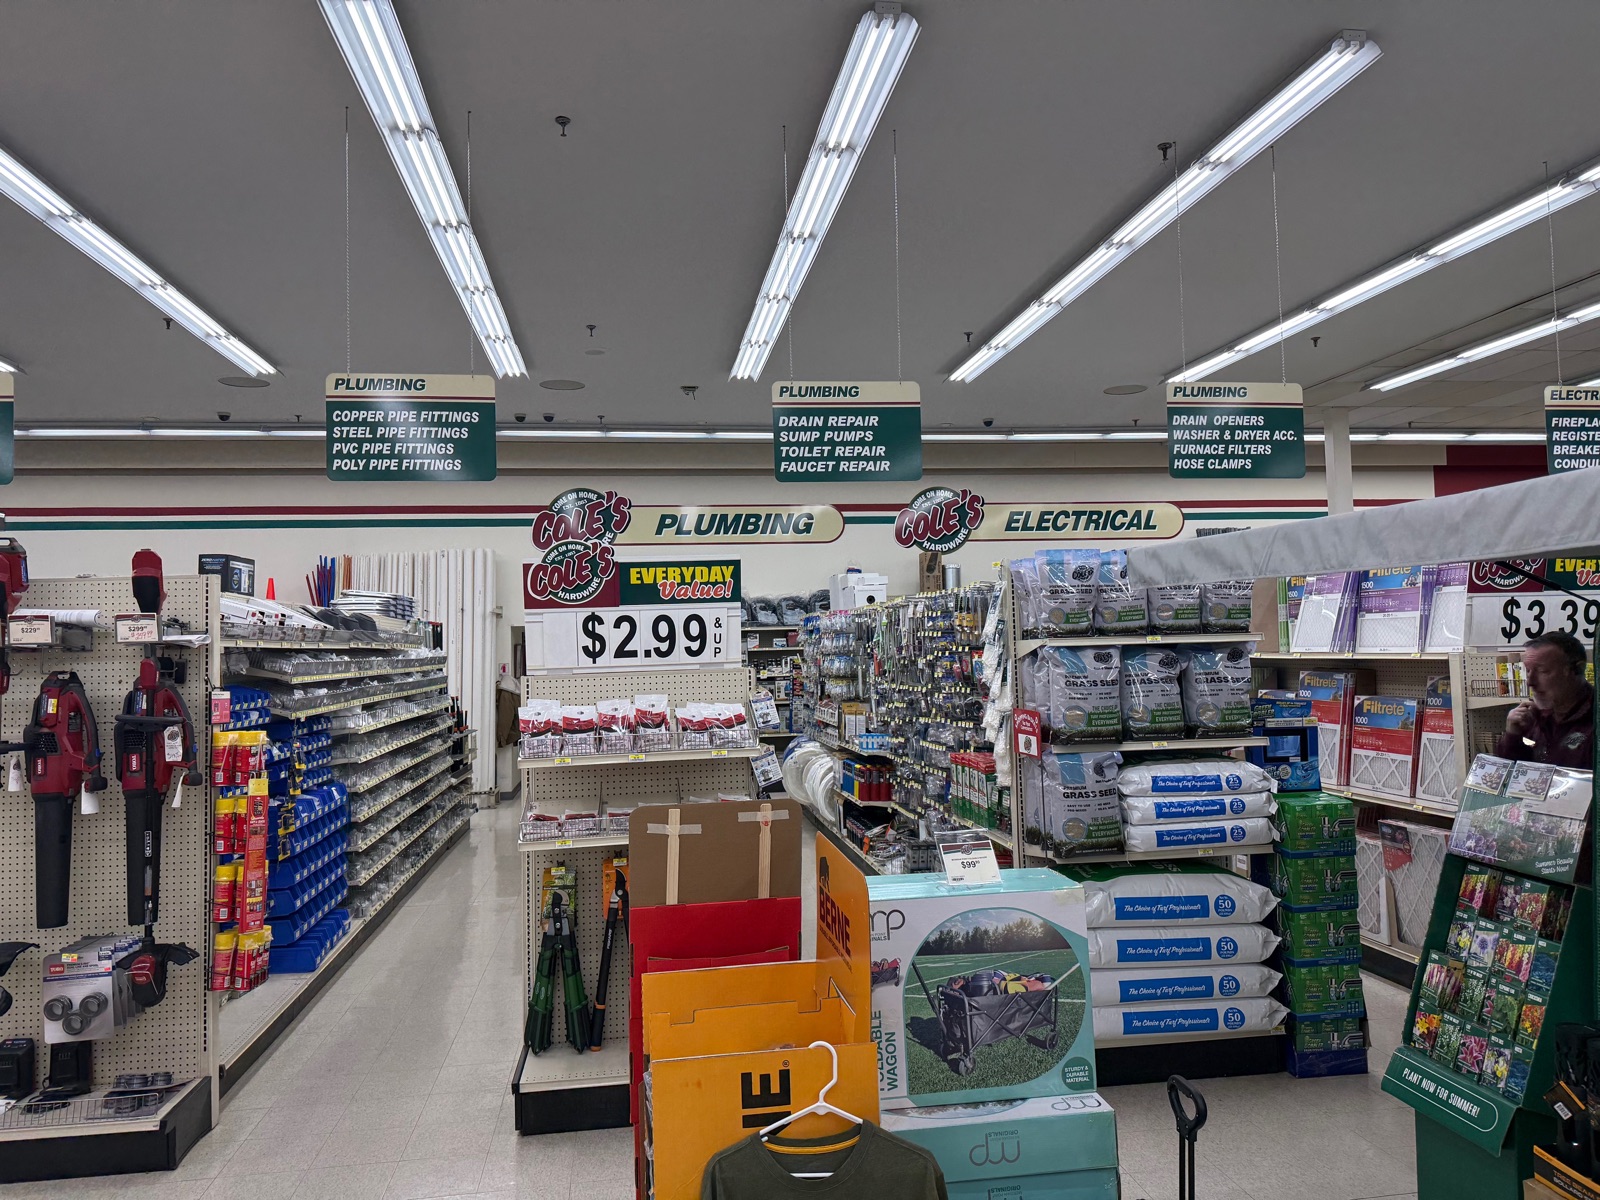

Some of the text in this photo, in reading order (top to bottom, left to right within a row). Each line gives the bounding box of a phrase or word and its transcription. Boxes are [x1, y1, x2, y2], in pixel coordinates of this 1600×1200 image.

[334, 378, 426, 391] PLUMBING
[779, 385, 860, 398] PLUMBING
[1173, 386, 1248, 398] PLUMBING
[1550, 390, 1600, 401] ELECTR
[332, 410, 480, 423] COPPER PIPE FITTINGS
[778, 415, 879, 427] DRAIN REPAIR
[1172, 415, 1264, 426] DRAIN OPENERS
[332, 427, 469, 439] STEEL PIPE FITTINGS
[779, 430, 874, 442] SUMP PUMPS
[1173, 430, 1297, 441] WASHER & DRYER ACC.
[332, 443, 454, 455] PVC PIPE FITTINGS
[780, 446, 886, 457] TOILET REPAIR
[1173, 444, 1272, 455] FURNACE FILTERS
[332, 459, 462, 471] POLY PIPE FITTINGS
[780, 461, 890, 473] FAUCET REPAIR
[1174, 458, 1252, 469] HOSE CLAMPS
[552, 491, 598, 512] COME ON HOME
[912, 495, 927, 509] COME
[936, 490, 954, 498] HOME
[532, 490, 631, 551] COLE'S
[655, 512, 814, 536] PLUMBING
[895, 488, 983, 548] COLE'S
[1004, 509, 1158, 532] ELECTRICAL
[922, 527, 969, 552] HARDWARE
[545, 547, 559, 563] COME
[558, 544, 567, 552] ON
[529, 541, 614, 598] COLE'S
[1555, 558, 1600, 572] EVER
[629, 565, 735, 585] EVERYDAY
[558, 576, 601, 600] HARDWARE
[659, 580, 733, 600] Value!
[1361, 581, 1374, 589] 1500
[713, 616, 723, 629] &
[1501, 596, 1600, 644] $339
[581, 612, 708, 664] $2.99
[1064, 679, 1119, 688] GRASS SEED
[1125, 678, 1160, 687] GRASS
[1194, 676, 1230, 685] GRASS
[1304, 675, 1338, 688] Filtrete
[1299, 690, 1312, 698] 1000
[1362, 700, 1405, 716] Filtrete
[1354, 716, 1369, 724] 1000
[1062, 787, 1117, 799] GRASS SEED
[1232, 801, 1243, 809] 25
[1535, 857, 1574, 869] Summer Beauty
[1541, 867, 1556, 875] Starts
[1133, 904, 1151, 912] Choice
[1151, 904, 1158, 914] of
[1157, 904, 1169, 914] Turf
[1168, 903, 1201, 913] Professionals
[1218, 899, 1232, 909] 50
[819, 885, 851, 960] BERNE
[1126, 947, 1136, 955] The
[1153, 947, 1160, 957] of
[1159, 946, 1171, 956] Turf
[1171, 946, 1203, 956] Professionals
[1220, 941, 1234, 951] 50
[1138, 987, 1155, 995] Choice
[1156, 987, 1162, 996] of
[1162, 986, 1174, 996] Turf
[1173, 985, 1206, 995] Professionals
[1223, 980, 1236, 990] 50
[1142, 1019, 1159, 1027] Choice
[1160, 1019, 1166, 1028] of
[1165, 1018, 1178, 1028] Turf
[1177, 1017, 1210, 1027] Professionals
[1227, 1013, 1241, 1022] 50
[884, 1031, 899, 1092] WAGON
[1064, 1065, 1085, 1073] STURDY
[1065, 1070, 1089, 1078] DURABLE
[1402, 1067, 1481, 1118] PLANT NOW FOR SUMMER!
[987, 1129, 1019, 1138] ORIGINALS
[990, 1184, 1021, 1194] ORIGINALS
